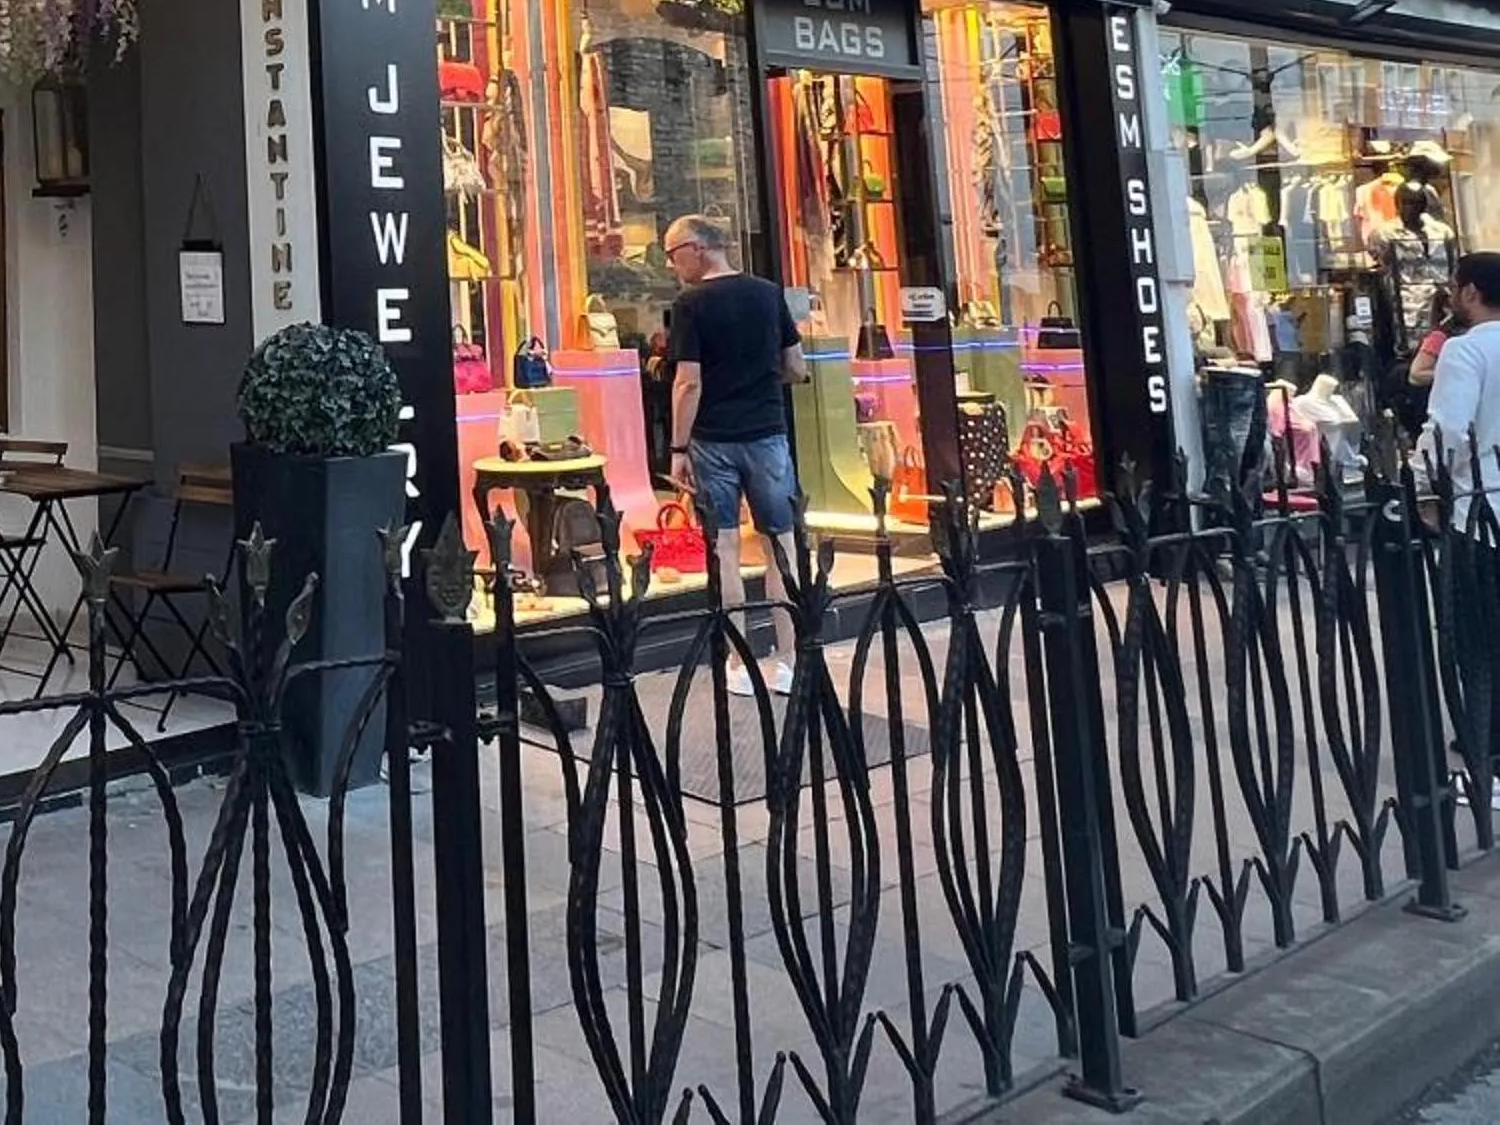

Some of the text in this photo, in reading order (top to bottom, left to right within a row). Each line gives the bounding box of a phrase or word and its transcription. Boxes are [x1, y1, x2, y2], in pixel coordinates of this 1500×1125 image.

[794, 15, 885, 58] BAGS
[1110, 16, 1167, 414] ESM SHOES
[368, 64, 423, 578] JEWERY
